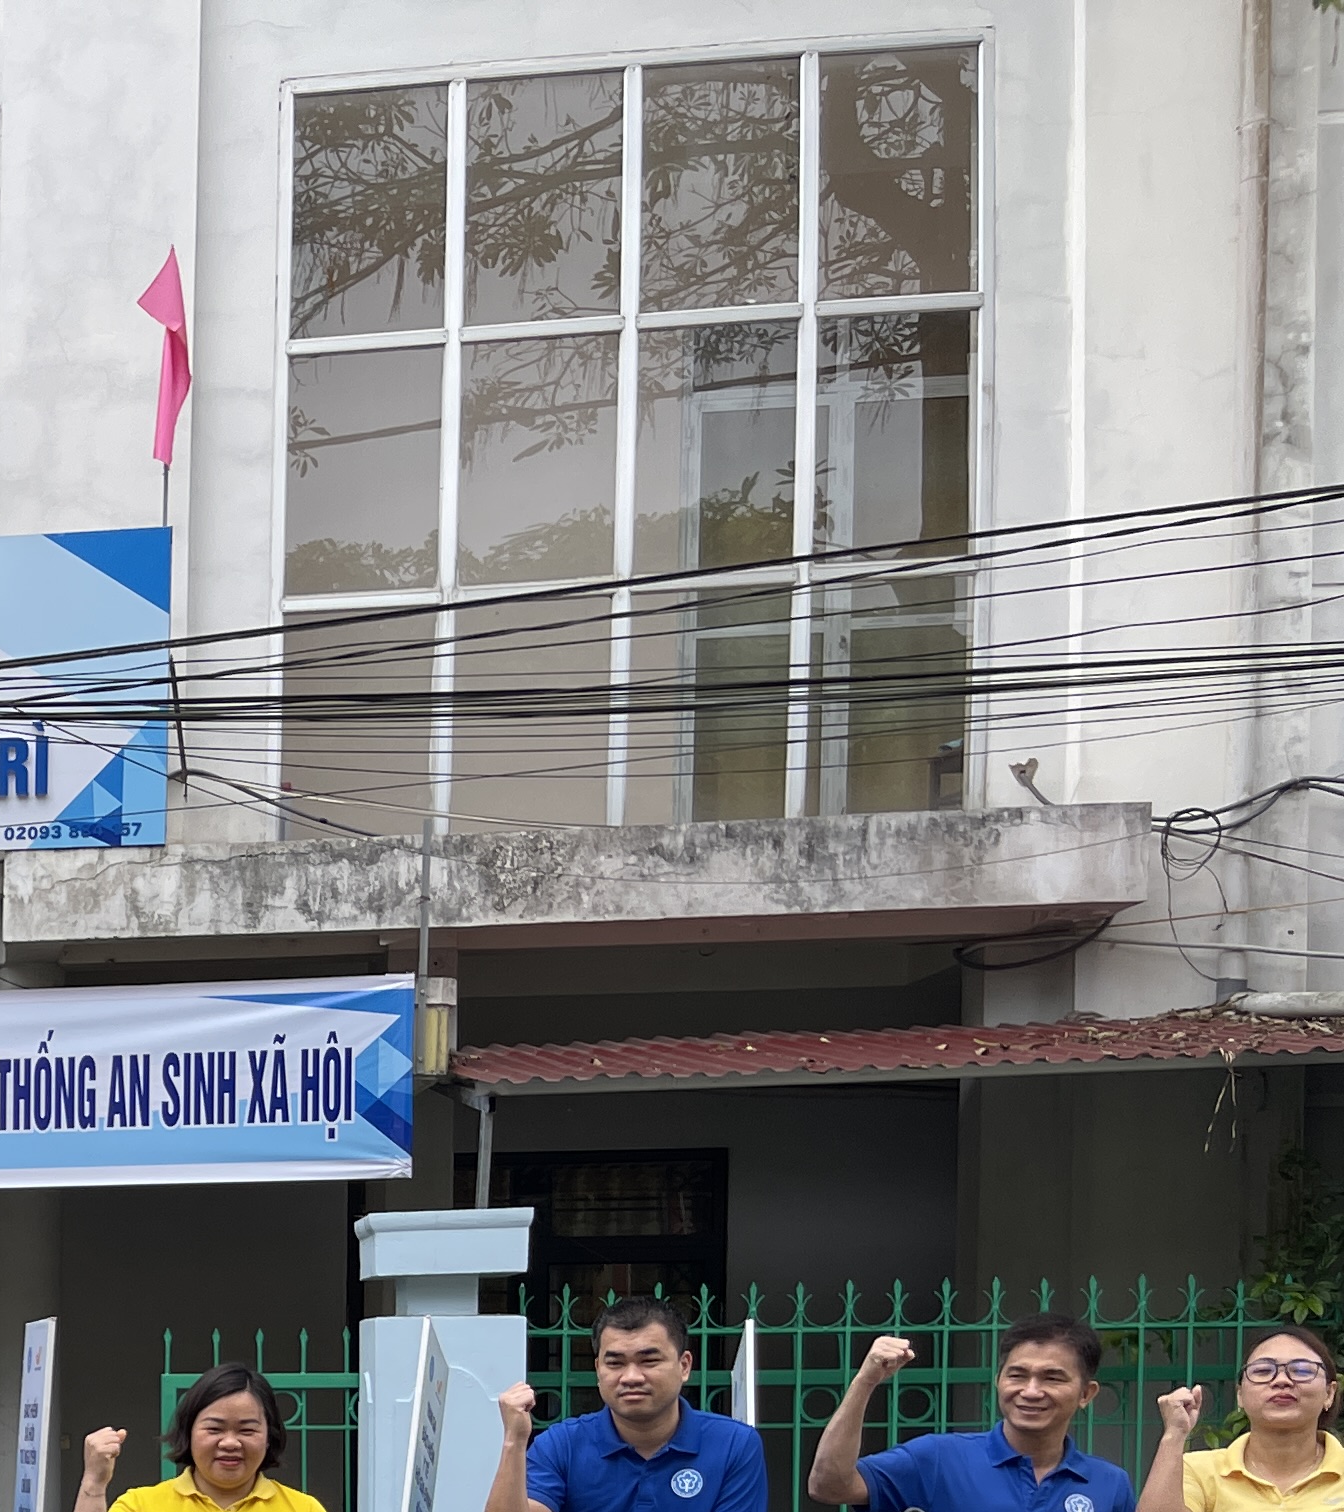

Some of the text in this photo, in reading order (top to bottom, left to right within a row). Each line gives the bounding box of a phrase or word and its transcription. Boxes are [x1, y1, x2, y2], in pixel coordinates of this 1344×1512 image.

[4, 825, 62, 841] 02093
[107, 1054, 151, 1129] AN
[161, 1050, 238, 1125] SINH
[247, 1034, 291, 1124] XÃ
[300, 1030, 355, 1143] HỘI
